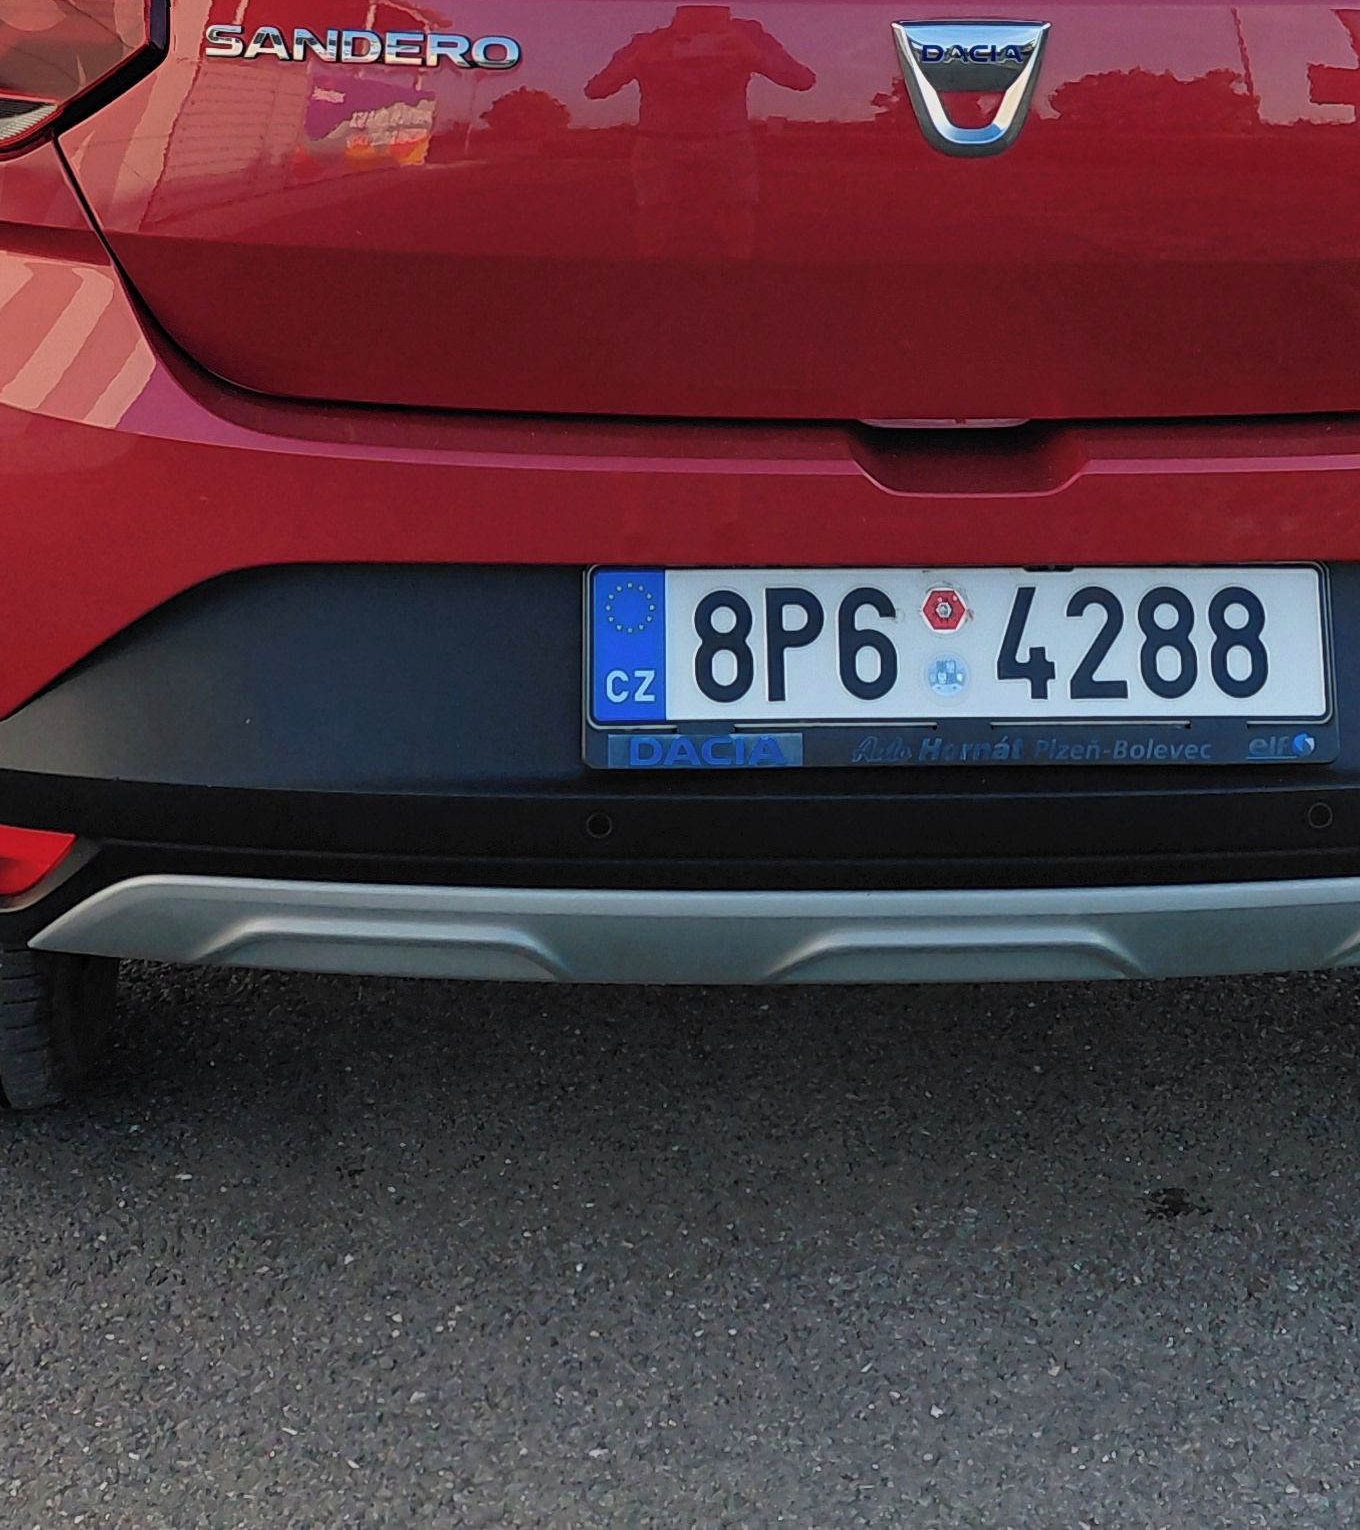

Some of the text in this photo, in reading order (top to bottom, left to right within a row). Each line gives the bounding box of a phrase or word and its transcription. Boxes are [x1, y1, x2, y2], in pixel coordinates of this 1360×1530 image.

[205, 24, 521, 70] SANDERO
[921, 43, 1024, 63] DACIA
[693, 585, 1270, 703] 8P6 4288
[606, 668, 657, 704] CZ
[628, 735, 787, 767] DACIA
[1034, 737, 1213, 762] Plzeň-Bolevec
[1247, 734, 1291, 757] elf
